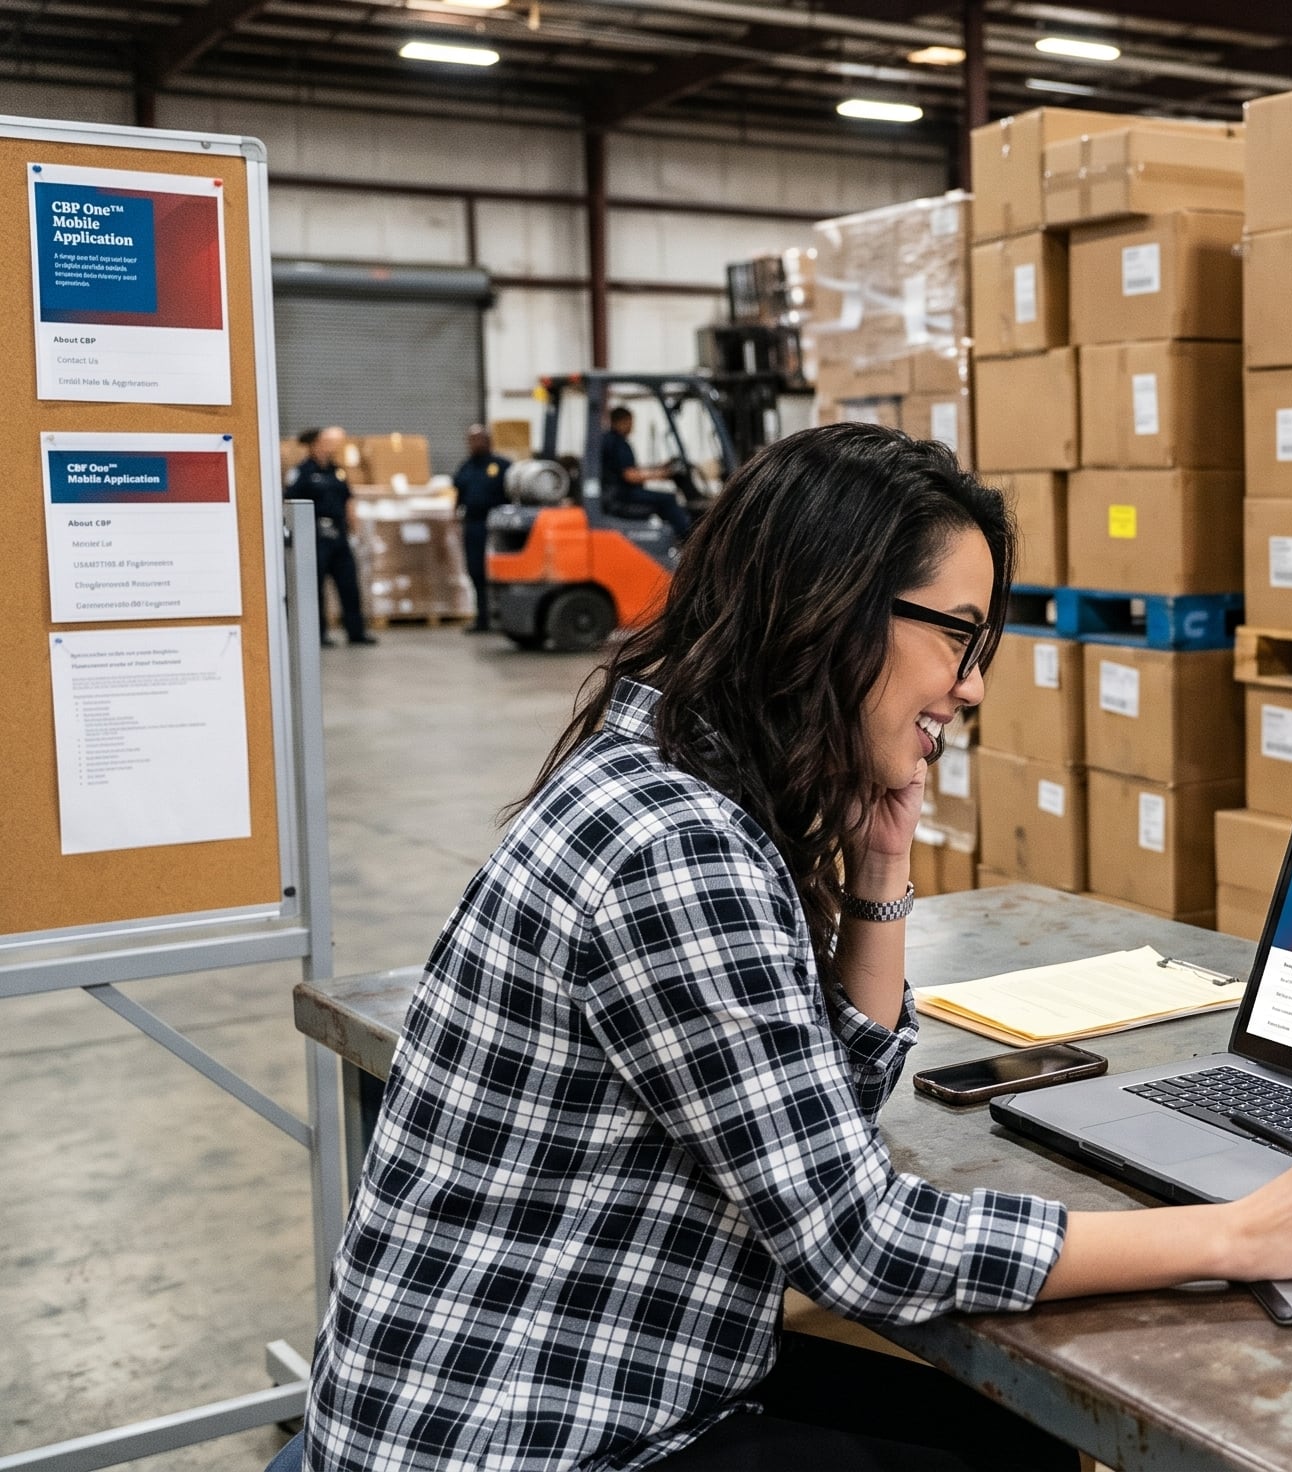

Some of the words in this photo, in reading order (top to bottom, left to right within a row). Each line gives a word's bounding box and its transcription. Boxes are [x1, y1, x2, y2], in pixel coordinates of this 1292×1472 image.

[52, 201, 80, 213] CBP
[53, 216, 100, 229] Mobile
[53, 230, 133, 246] Application
[104, 474, 160, 485] Application
